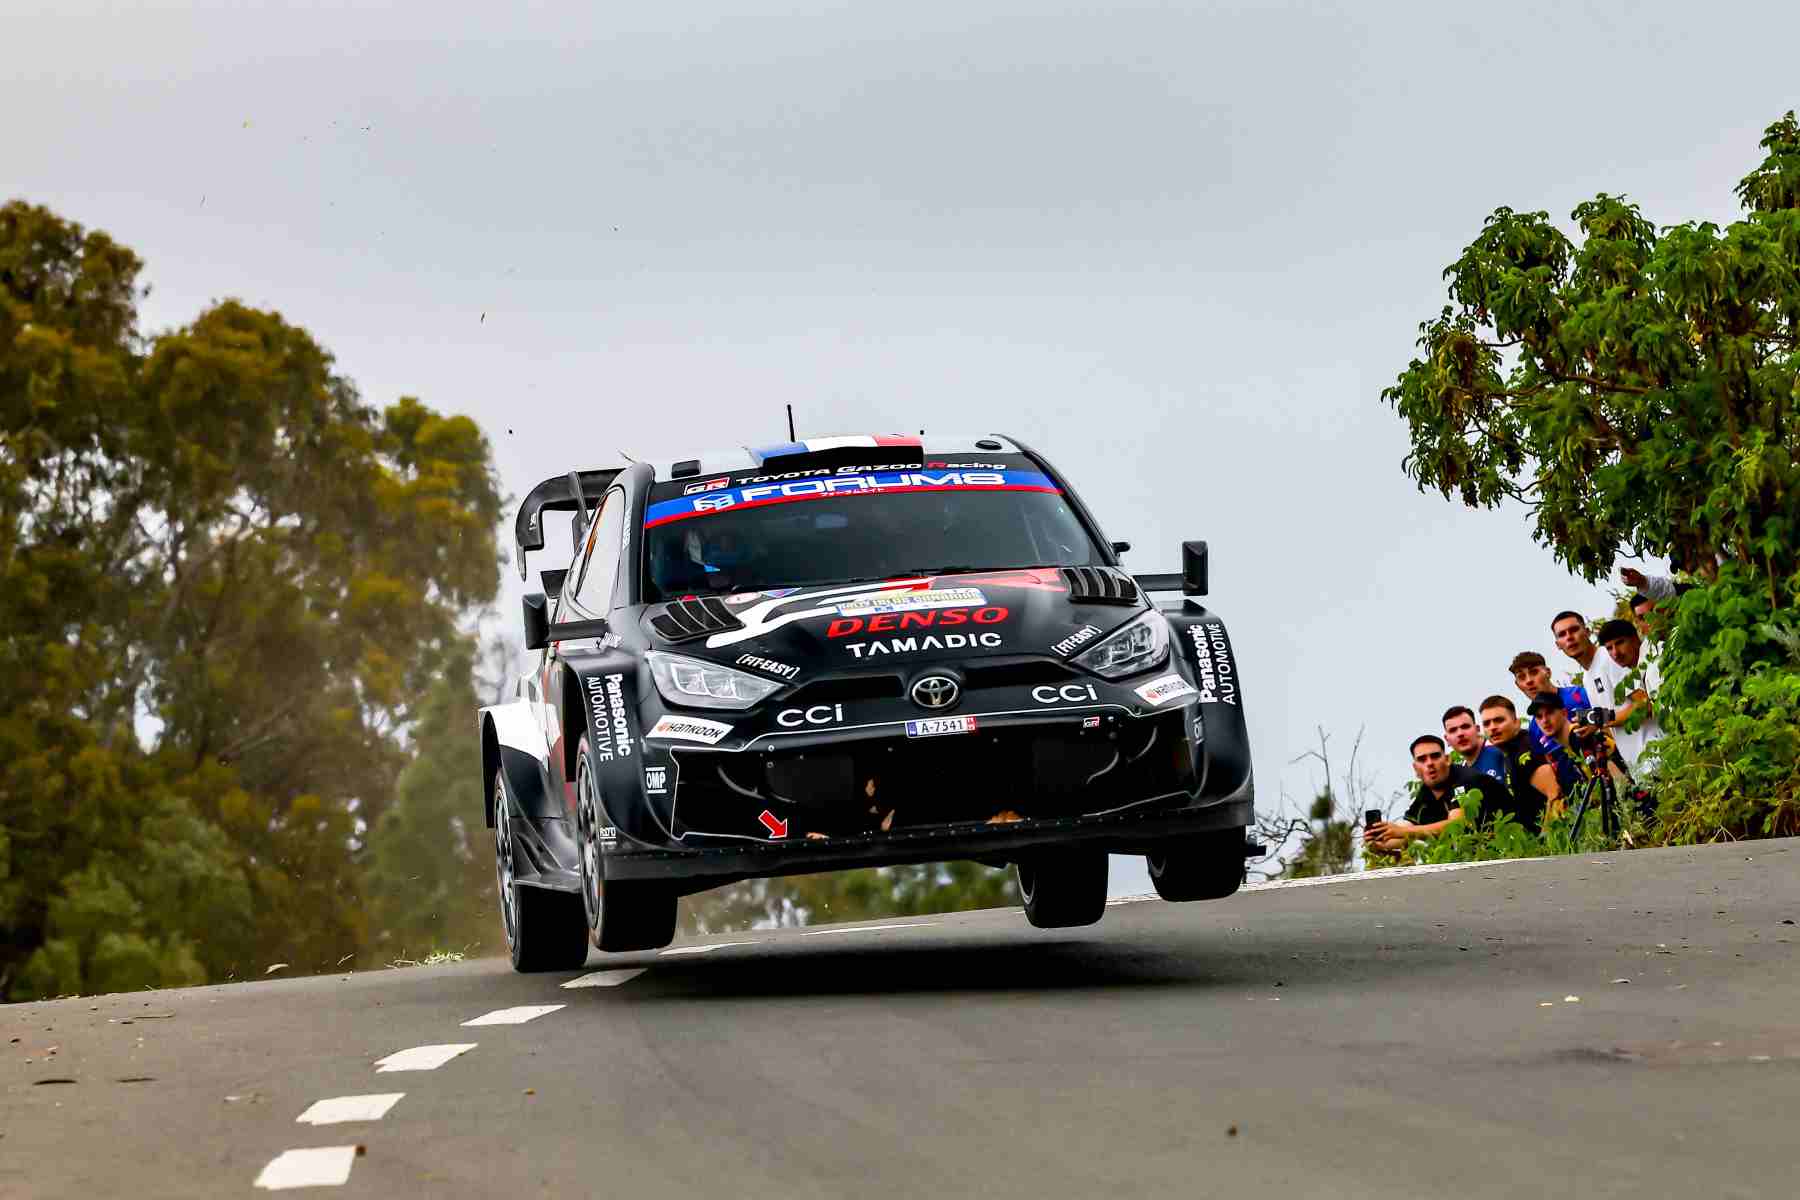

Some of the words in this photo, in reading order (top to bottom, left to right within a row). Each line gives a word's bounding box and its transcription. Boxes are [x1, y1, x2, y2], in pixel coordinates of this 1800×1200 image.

[736, 468, 830, 484] TOYOTA
[928, 461, 1007, 470] Racing
[741, 473, 1006, 501] FORUM8
[826, 607, 1009, 638] DENSO
[846, 632, 1002, 658] TAMADIC
[1187, 624, 1218, 703] Panasonic
[1206, 624, 1236, 705] AUTOMOTIVE
[586, 677, 614, 762] AUTOMOTIVE
[605, 674, 634, 756] Panasonic
[921, 719, 963, 733] A-7541
[646, 771, 666, 789] OMP
